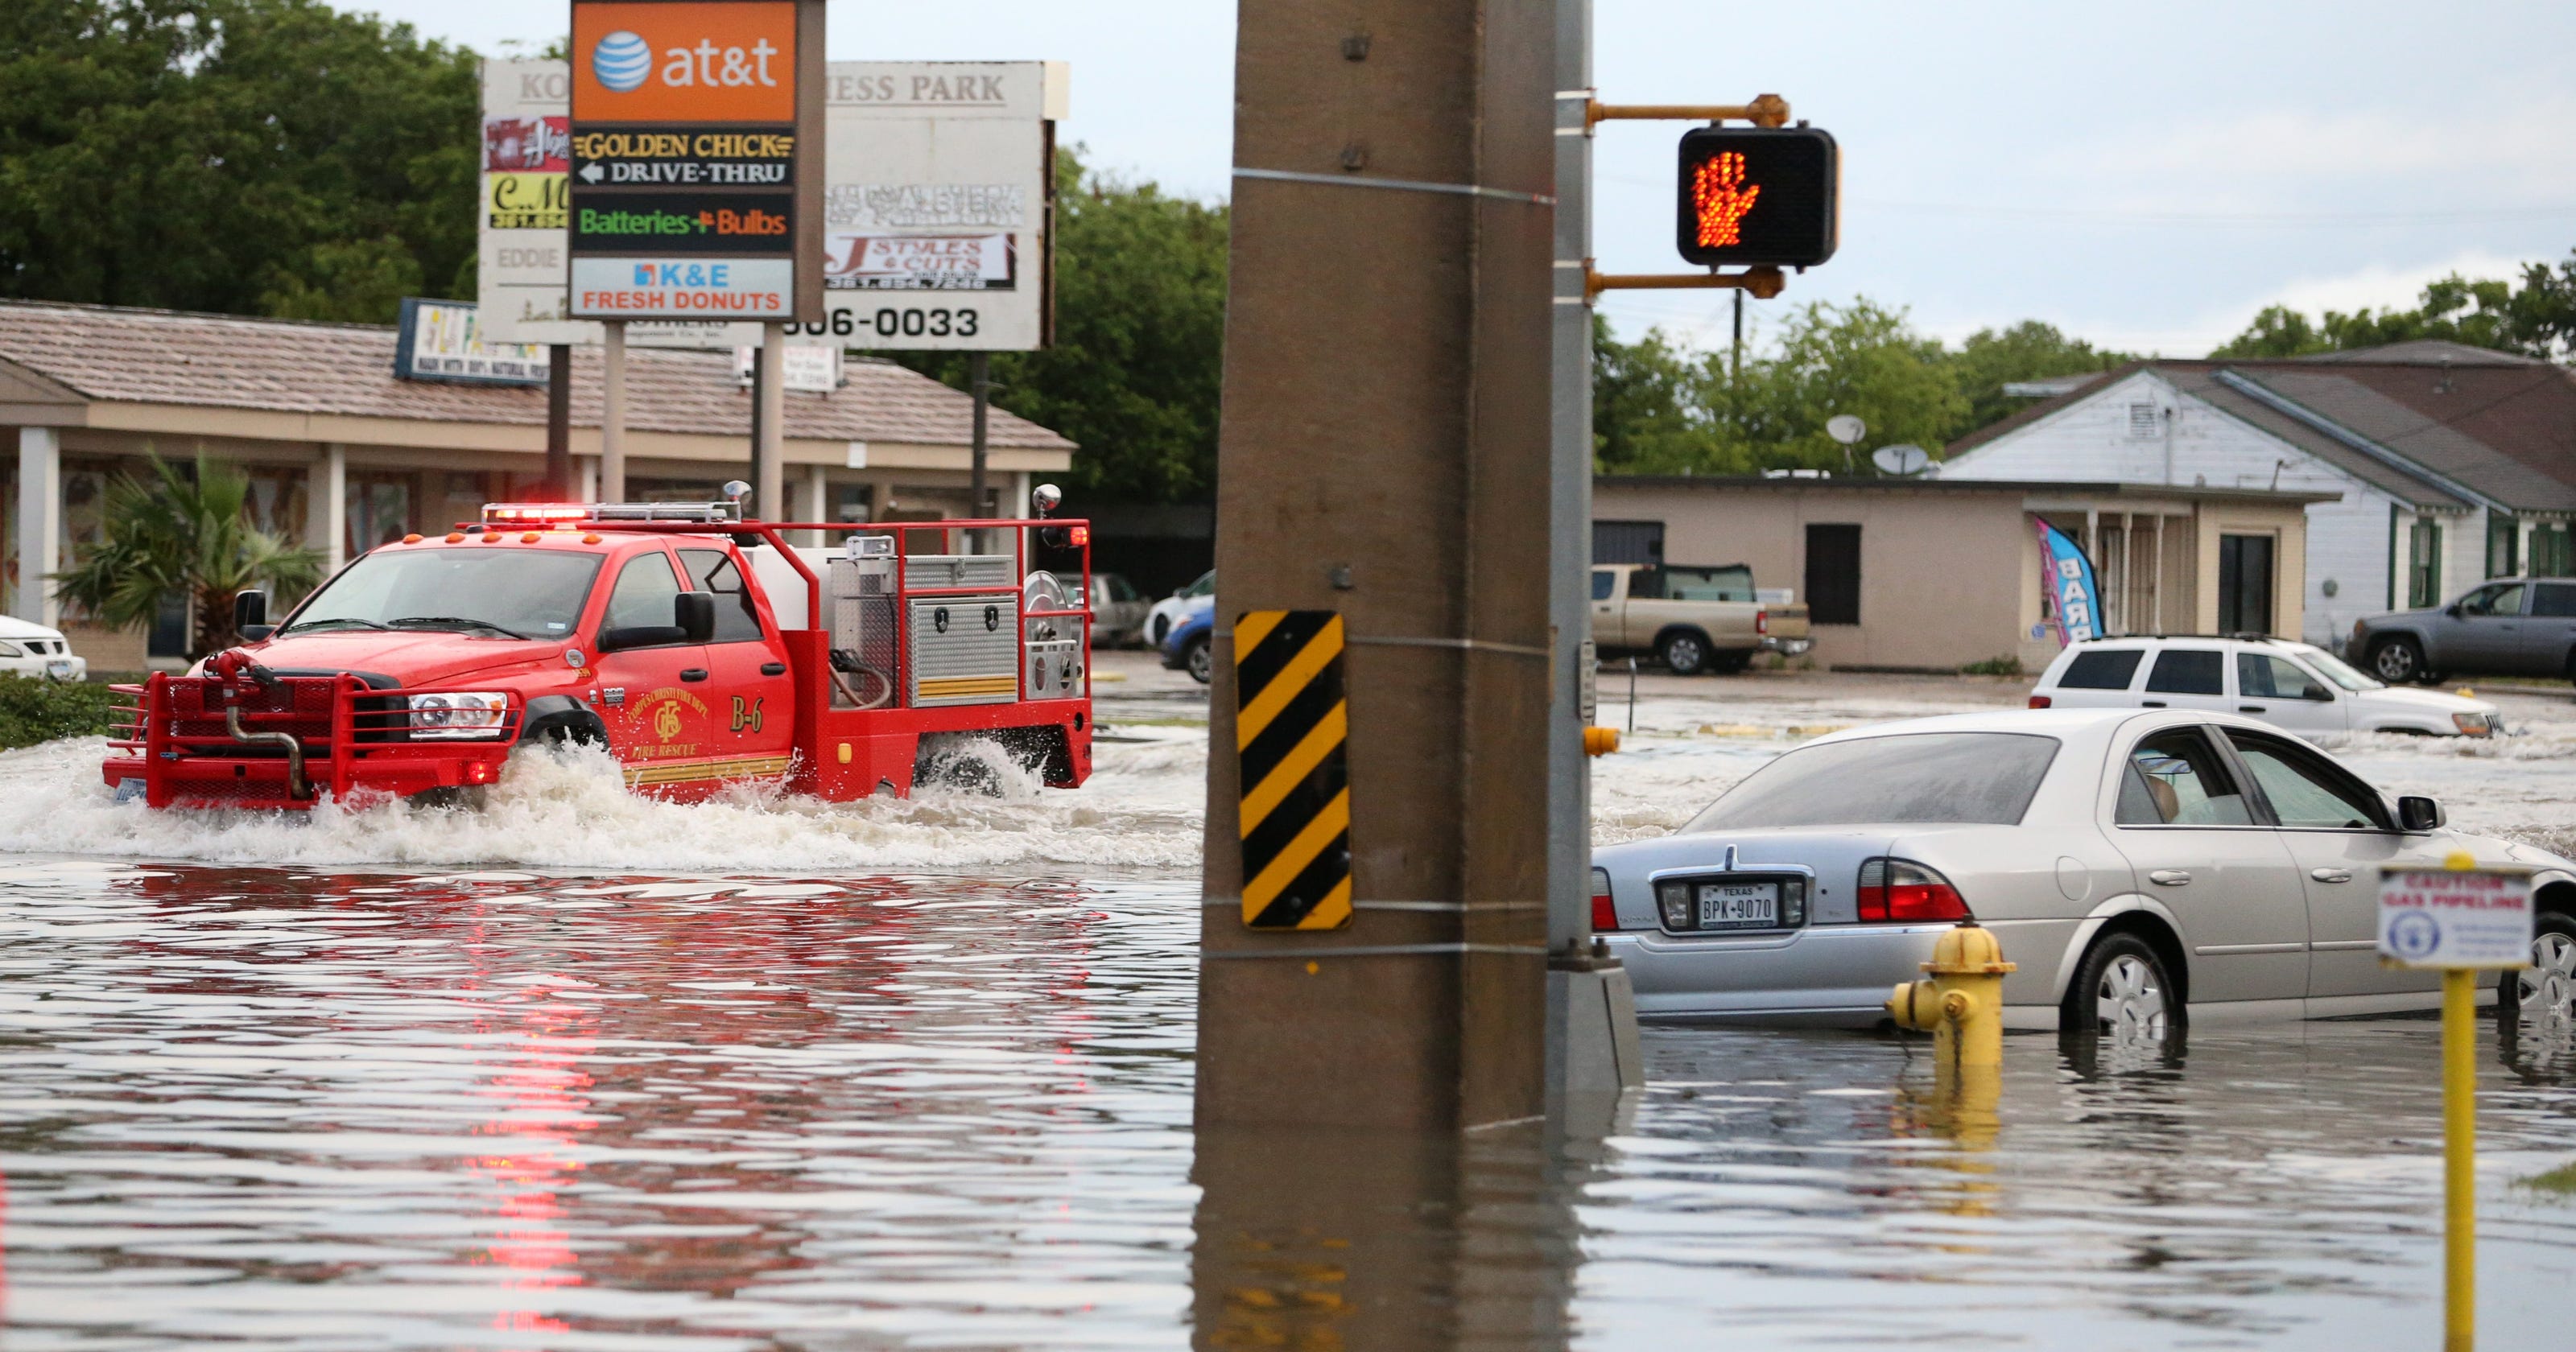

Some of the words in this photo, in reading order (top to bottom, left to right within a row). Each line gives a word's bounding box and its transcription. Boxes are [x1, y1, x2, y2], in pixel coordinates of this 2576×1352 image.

[662, 38, 778, 88] at&t
[910, 75, 1005, 101] PARK
[584, 133, 689, 159] GOLDEN
[694, 134, 779, 158] CHICK
[611, 163, 786, 183] DRIVE-THRU
[580, 208, 690, 234] Batteries
[716, 209, 786, 235] Bulbs
[497, 248, 559, 268] EDDIE
[872, 241, 982, 256] STYLES
[903, 257, 980, 271] CUTS
[661, 264, 730, 287] K&E
[582, 291, 664, 310] FRESH
[675, 291, 781, 311] DONUTS
[730, 695, 764, 734] B-6
[632, 746, 656, 757] FIRE
[658, 743, 697, 756] RESCUE
[2405, 874, 2505, 890] CAUTION
[1724, 888, 1753, 897] TEXAS
[2383, 892, 2424, 907] GAS
[2431, 894, 2524, 909] PIPELINE
